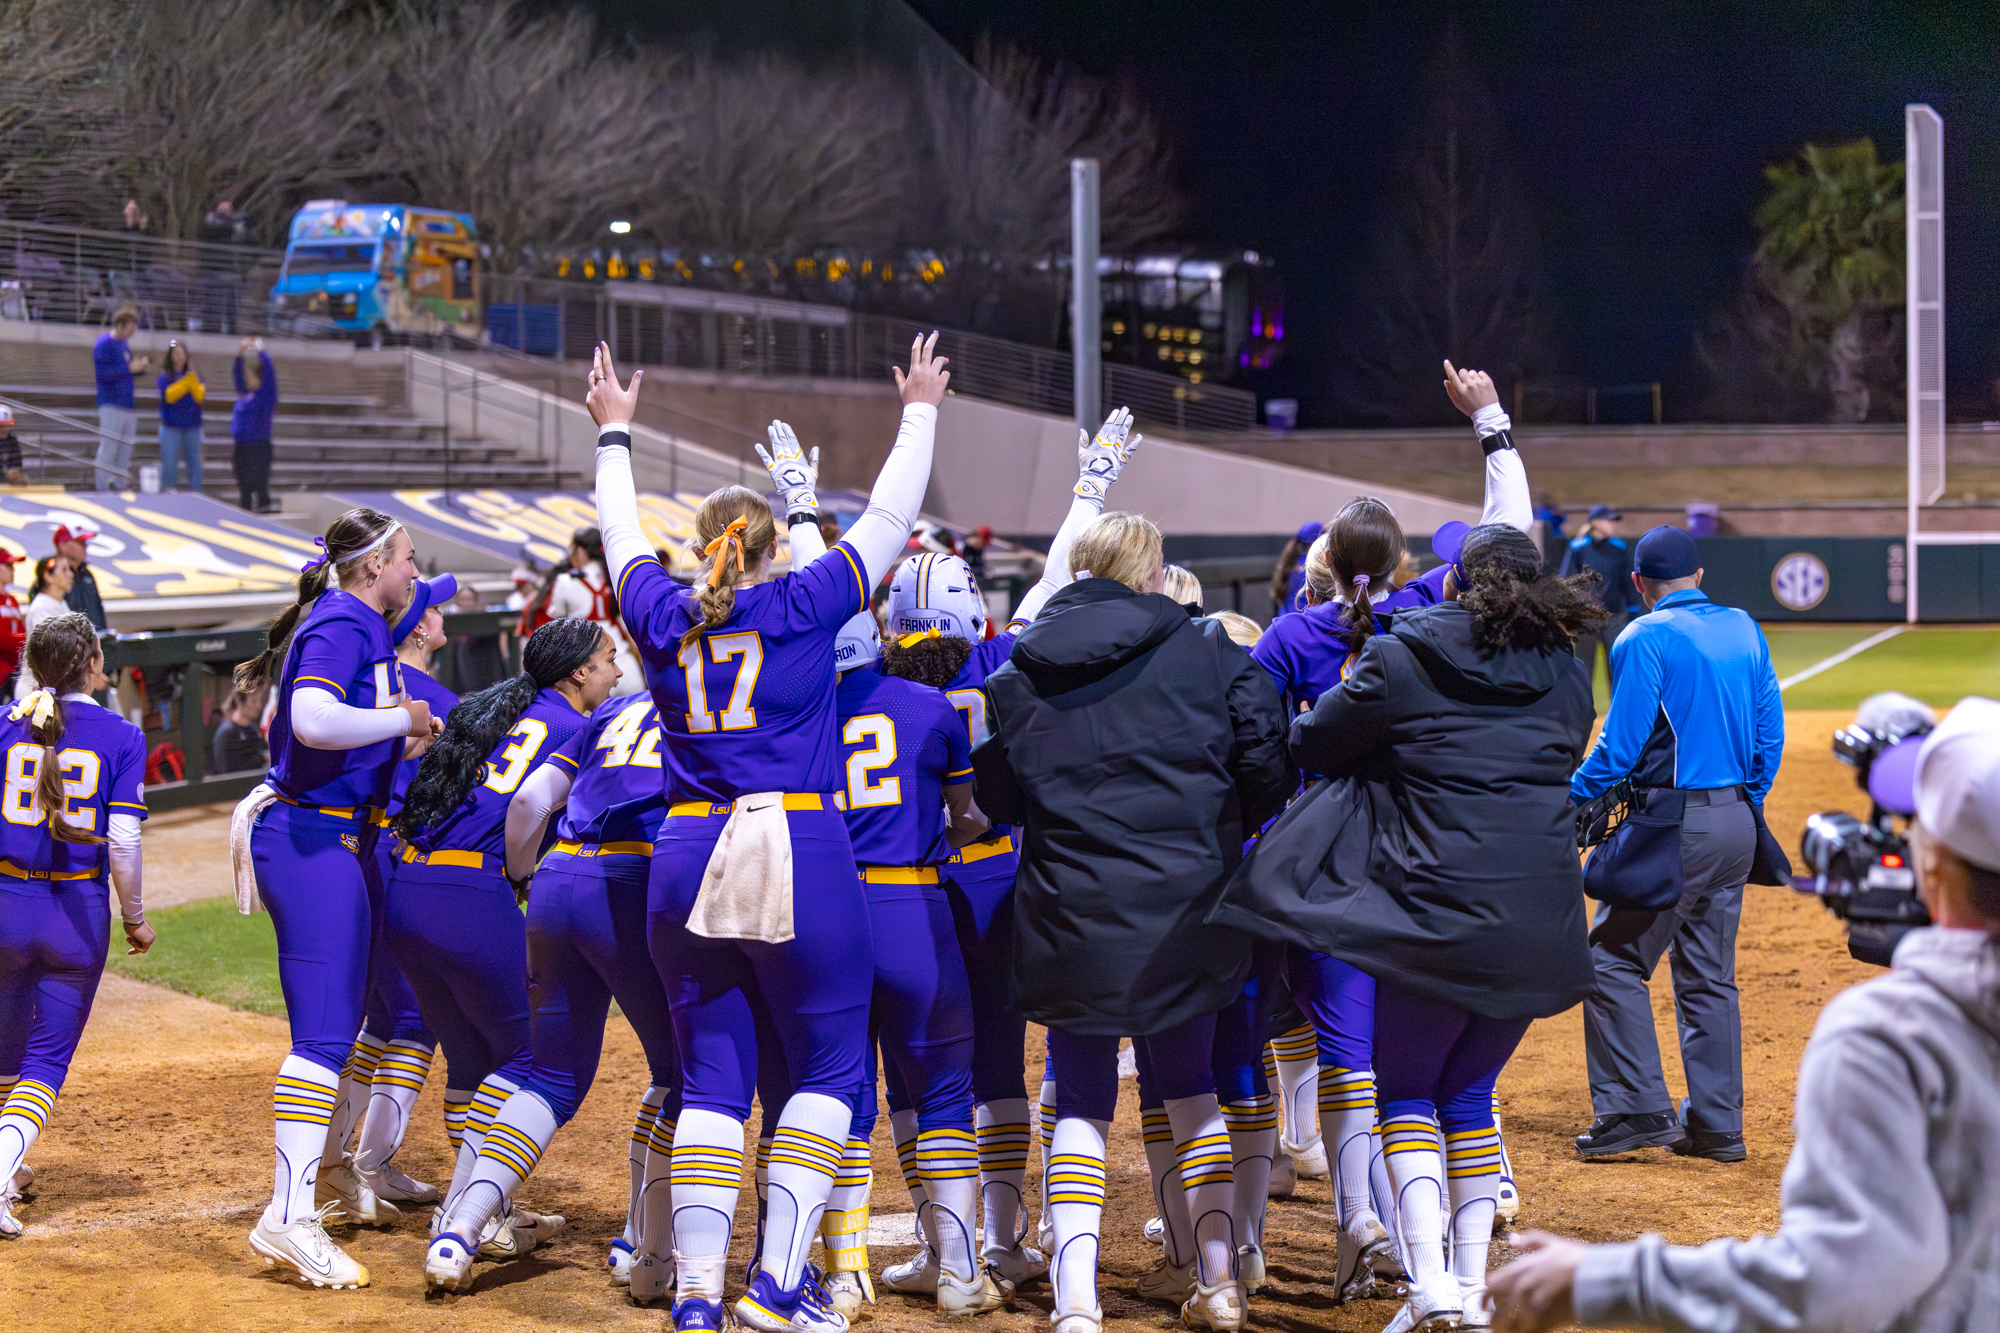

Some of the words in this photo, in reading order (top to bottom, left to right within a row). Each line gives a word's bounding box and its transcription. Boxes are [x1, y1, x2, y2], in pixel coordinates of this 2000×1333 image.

[900, 618, 950, 632] FRANKLIN
[678, 630, 764, 734] 17
[595, 702, 662, 768] 42
[833, 713, 901, 811] 2
[1, 742, 101, 831] 82
[711, 806, 731, 815] LSU
[577, 849, 597, 857] LSU
[30, 871, 48, 879] LSU
[685, 1317, 705, 1327] TIGERS
